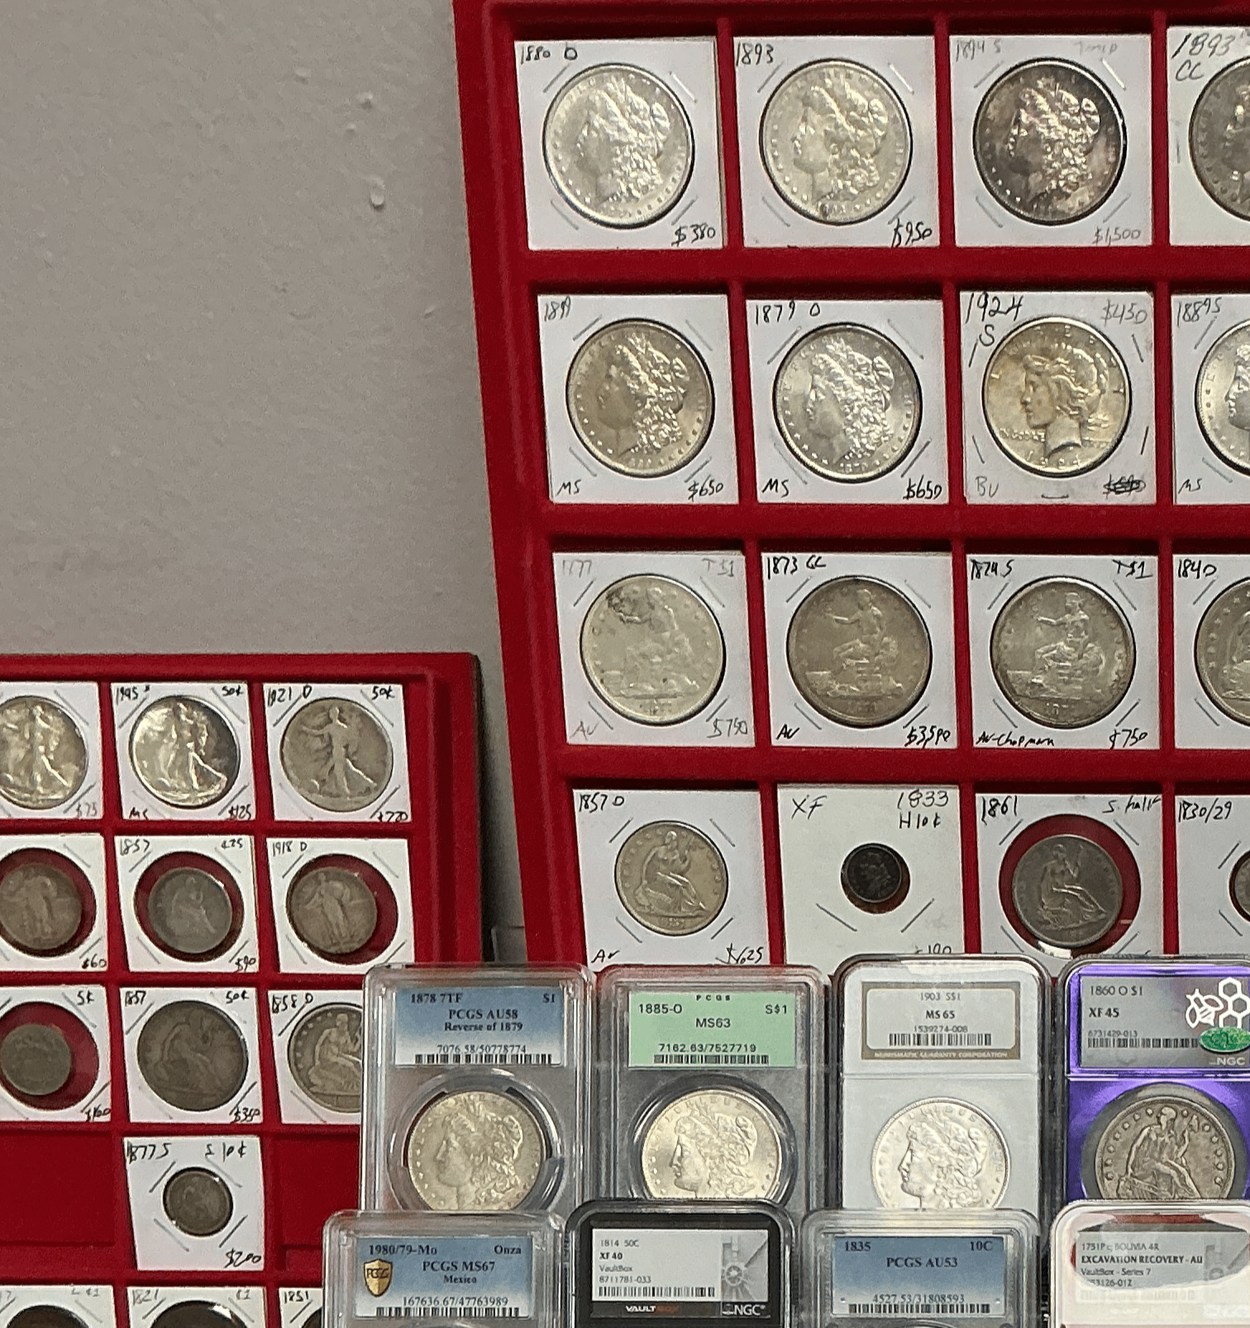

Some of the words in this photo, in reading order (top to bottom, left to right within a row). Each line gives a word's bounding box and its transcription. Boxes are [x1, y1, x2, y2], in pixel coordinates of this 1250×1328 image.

[735, 43, 774, 67] 1893
[1170, 32, 1231, 57] 1893
[1175, 62, 1204, 79] CC
[672, 226, 716, 247] $380
[890, 222, 932, 249] $950
[754, 302, 796, 325] 1879
[964, 292, 1022, 323] 1924
[1101, 299, 1148, 327] $450
[557, 481, 581, 496] MS
[688, 478, 724, 501] $650
[762, 480, 791, 498] MS
[902, 475, 942, 502] $650
[766, 555, 799, 580] 1873
[706, 718, 747, 741] $750
[1109, 728, 1148, 750] $750
[792, 793, 827, 819] XF
[897, 790, 950, 811] 1833
[981, 795, 1019, 824] 1861
[1178, 798, 1233, 822] 1830/29
[449, 1009, 485, 1021] PCGS
[487, 1009, 519, 1021] AU58
[638, 1004, 683, 1015] 1885-O
[764, 1004, 788, 1015] S$1
[444, 1022, 483, 1032] Reverse
[499, 1022, 523, 1032] 1879
[694, 1017, 732, 1028] MS63
[1217, 1056, 1246, 1067] NGC
[843, 1241, 872, 1252] 1835
[969, 1241, 994, 1252] 10C
[422, 1260, 455, 1272] PCGS
[457, 1260, 496, 1272] MS67
[886, 1257, 922, 1268] PCGS
[925, 1257, 959, 1268] AU53
[443, 1274, 478, 1284] Mexico
[735, 1303, 762, 1316] NGC
